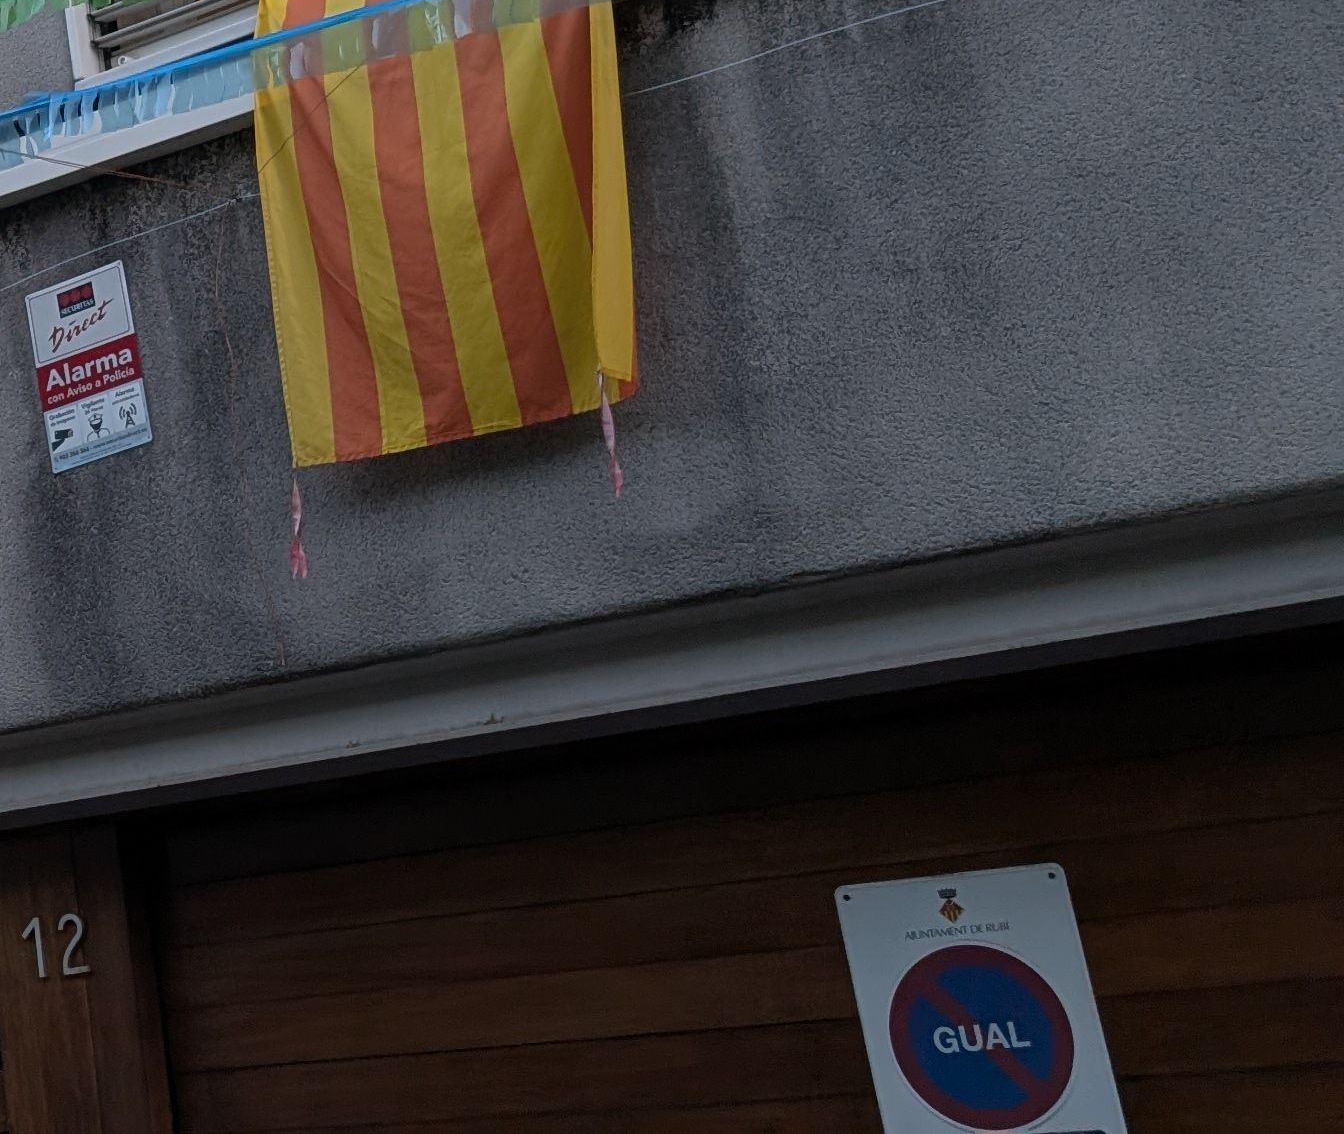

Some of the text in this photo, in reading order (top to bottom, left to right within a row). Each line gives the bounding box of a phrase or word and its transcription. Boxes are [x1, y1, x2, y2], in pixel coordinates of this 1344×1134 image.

[49, 299, 112, 353] Direct
[61, 299, 94, 316] SECURITAS
[46, 346, 133, 392] Alarma
[47, 366, 135, 405] con Aviso a Policía
[22, 914, 90, 977] 12
[905, 926, 968, 941] AJUNTAMENT
[970, 924, 984, 934] DE
[933, 1021, 1031, 1054] GUAL
